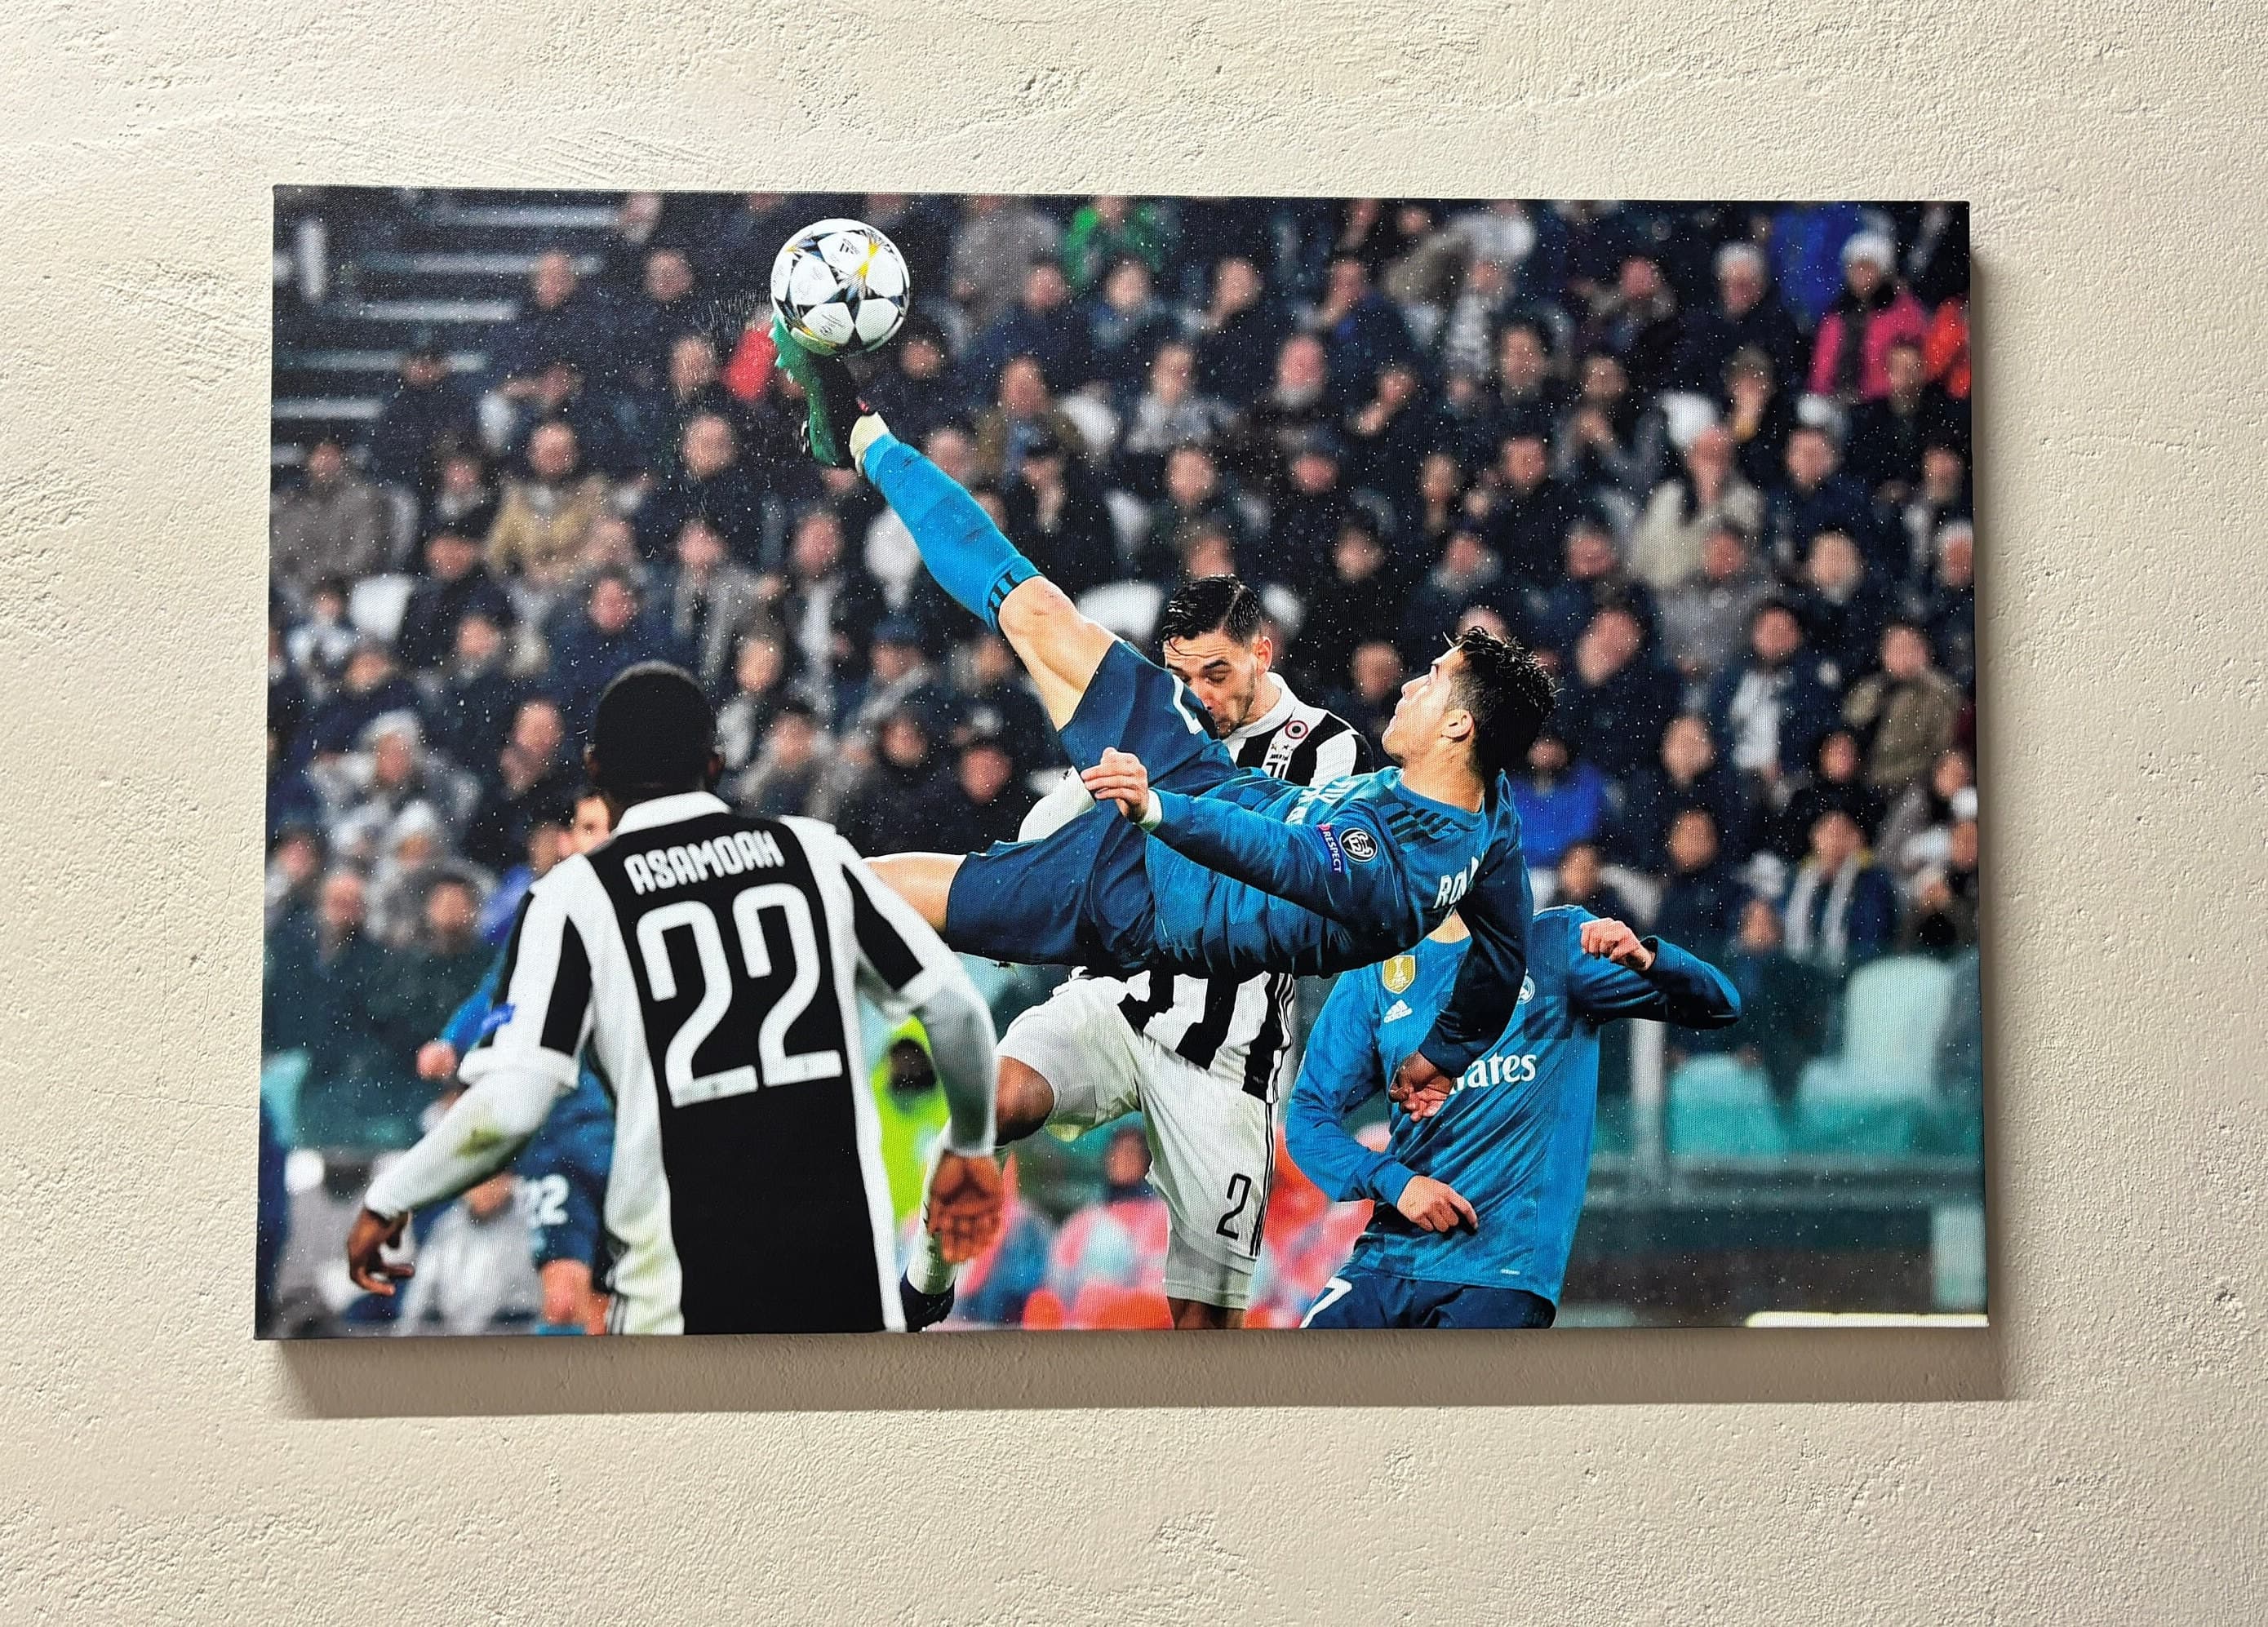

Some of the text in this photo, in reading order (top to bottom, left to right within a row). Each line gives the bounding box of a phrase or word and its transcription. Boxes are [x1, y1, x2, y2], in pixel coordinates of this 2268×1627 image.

[624, 830, 785, 895] ASAMOAH
[1322, 831, 1342, 873] RESPECT
[636, 883, 843, 1109] 22
[1449, 1052, 1537, 1095] rates
[1215, 1173, 1253, 1241] 2
